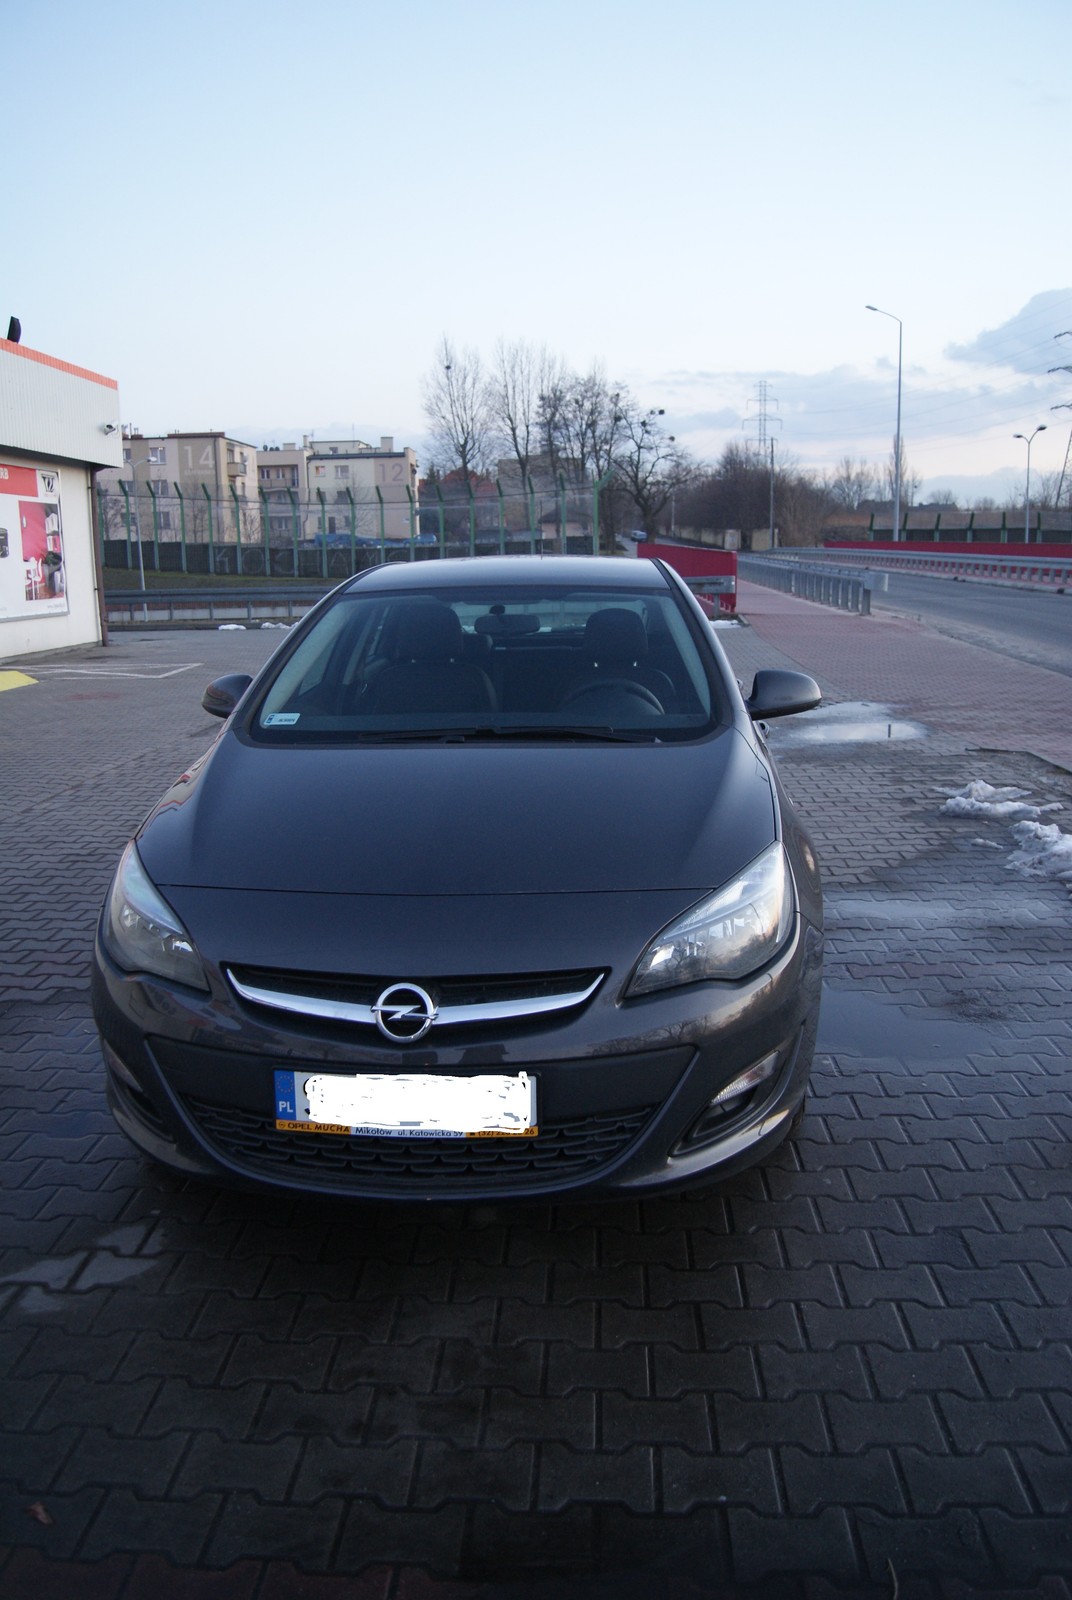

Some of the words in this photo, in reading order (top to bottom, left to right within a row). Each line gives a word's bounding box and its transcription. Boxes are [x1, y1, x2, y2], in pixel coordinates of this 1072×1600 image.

[183, 445, 215, 469] 14
[379, 463, 404, 482] 12
[278, 1100, 294, 1113] PL
[287, 1122, 312, 1131] OPEL
[314, 1123, 351, 1133] MUCHA
[355, 1126, 393, 1136] Mikołów
[397, 1129, 408, 1137] ul.
